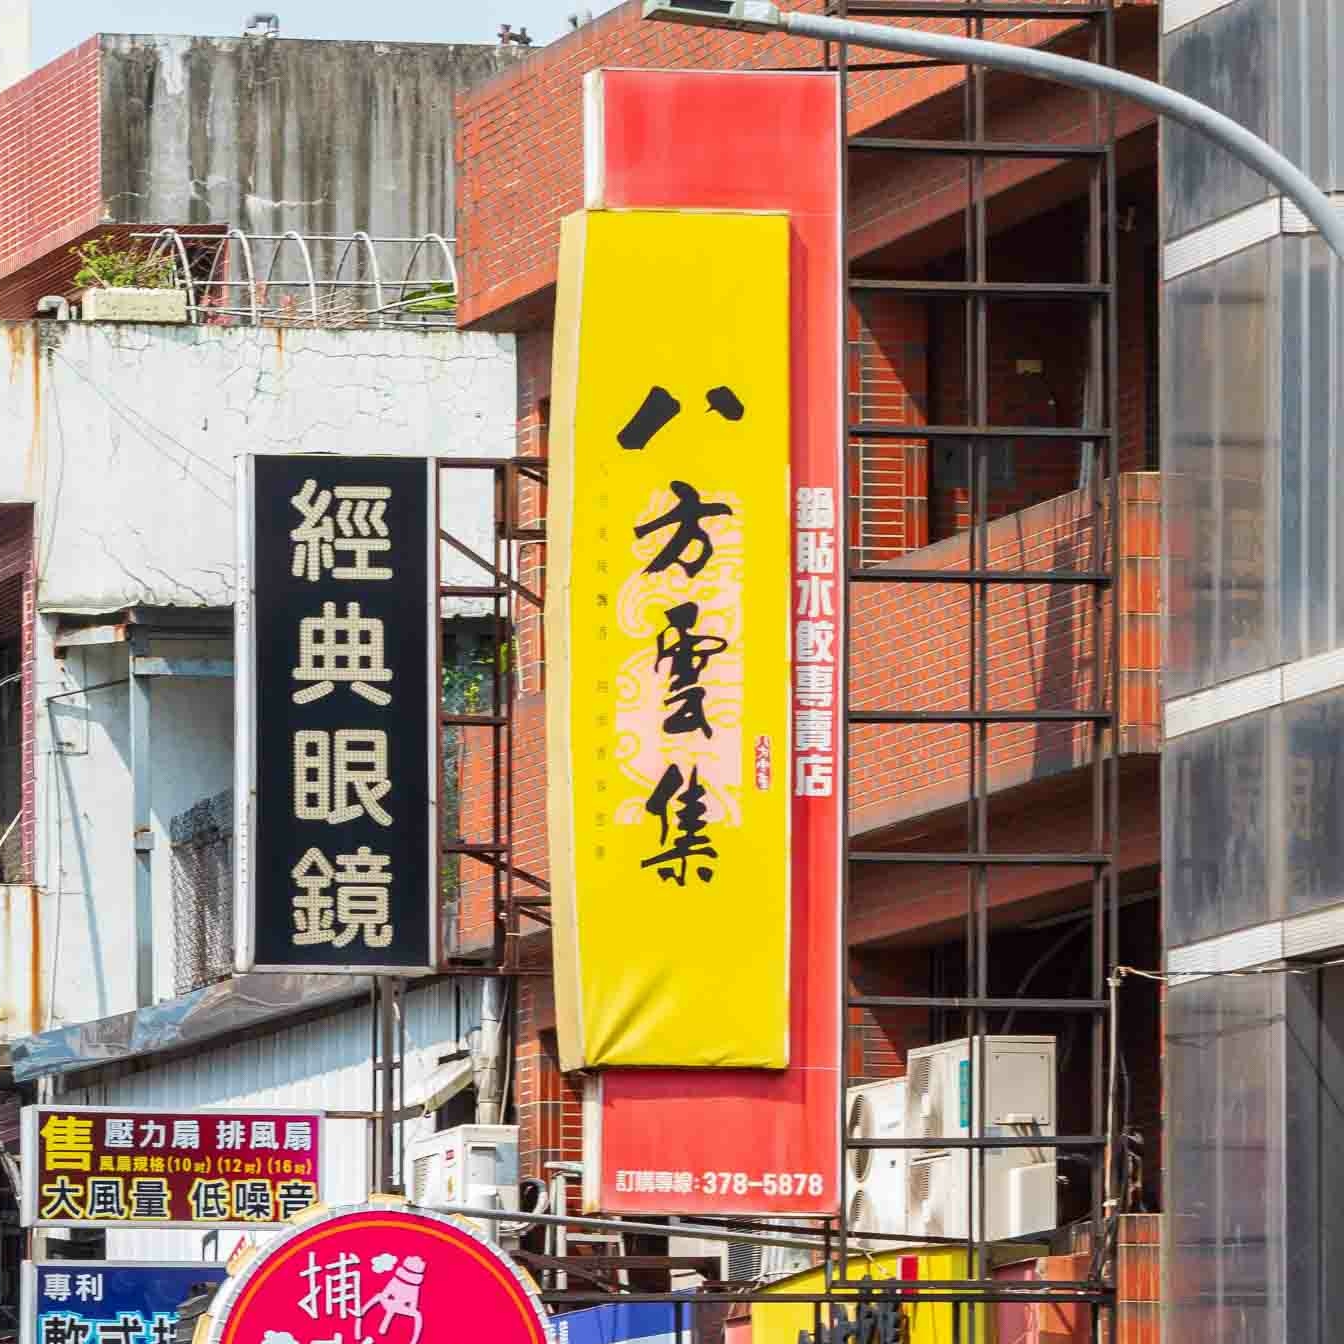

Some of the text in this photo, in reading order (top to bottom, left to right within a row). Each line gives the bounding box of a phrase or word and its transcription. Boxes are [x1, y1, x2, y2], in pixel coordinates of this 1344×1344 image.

[616, 385, 745, 887] 八方雲集
[794, 486, 836, 798] 鍋貼水餃專賣店
[291, 479, 393, 949] 經典眼鏡
[40, 1115, 94, 1171] 售
[104, 1118, 312, 1150] 壓力扇 排風扇
[42, 1176, 317, 1221] 大風量 低噪音
[43, 1273, 104, 1302] 專利
